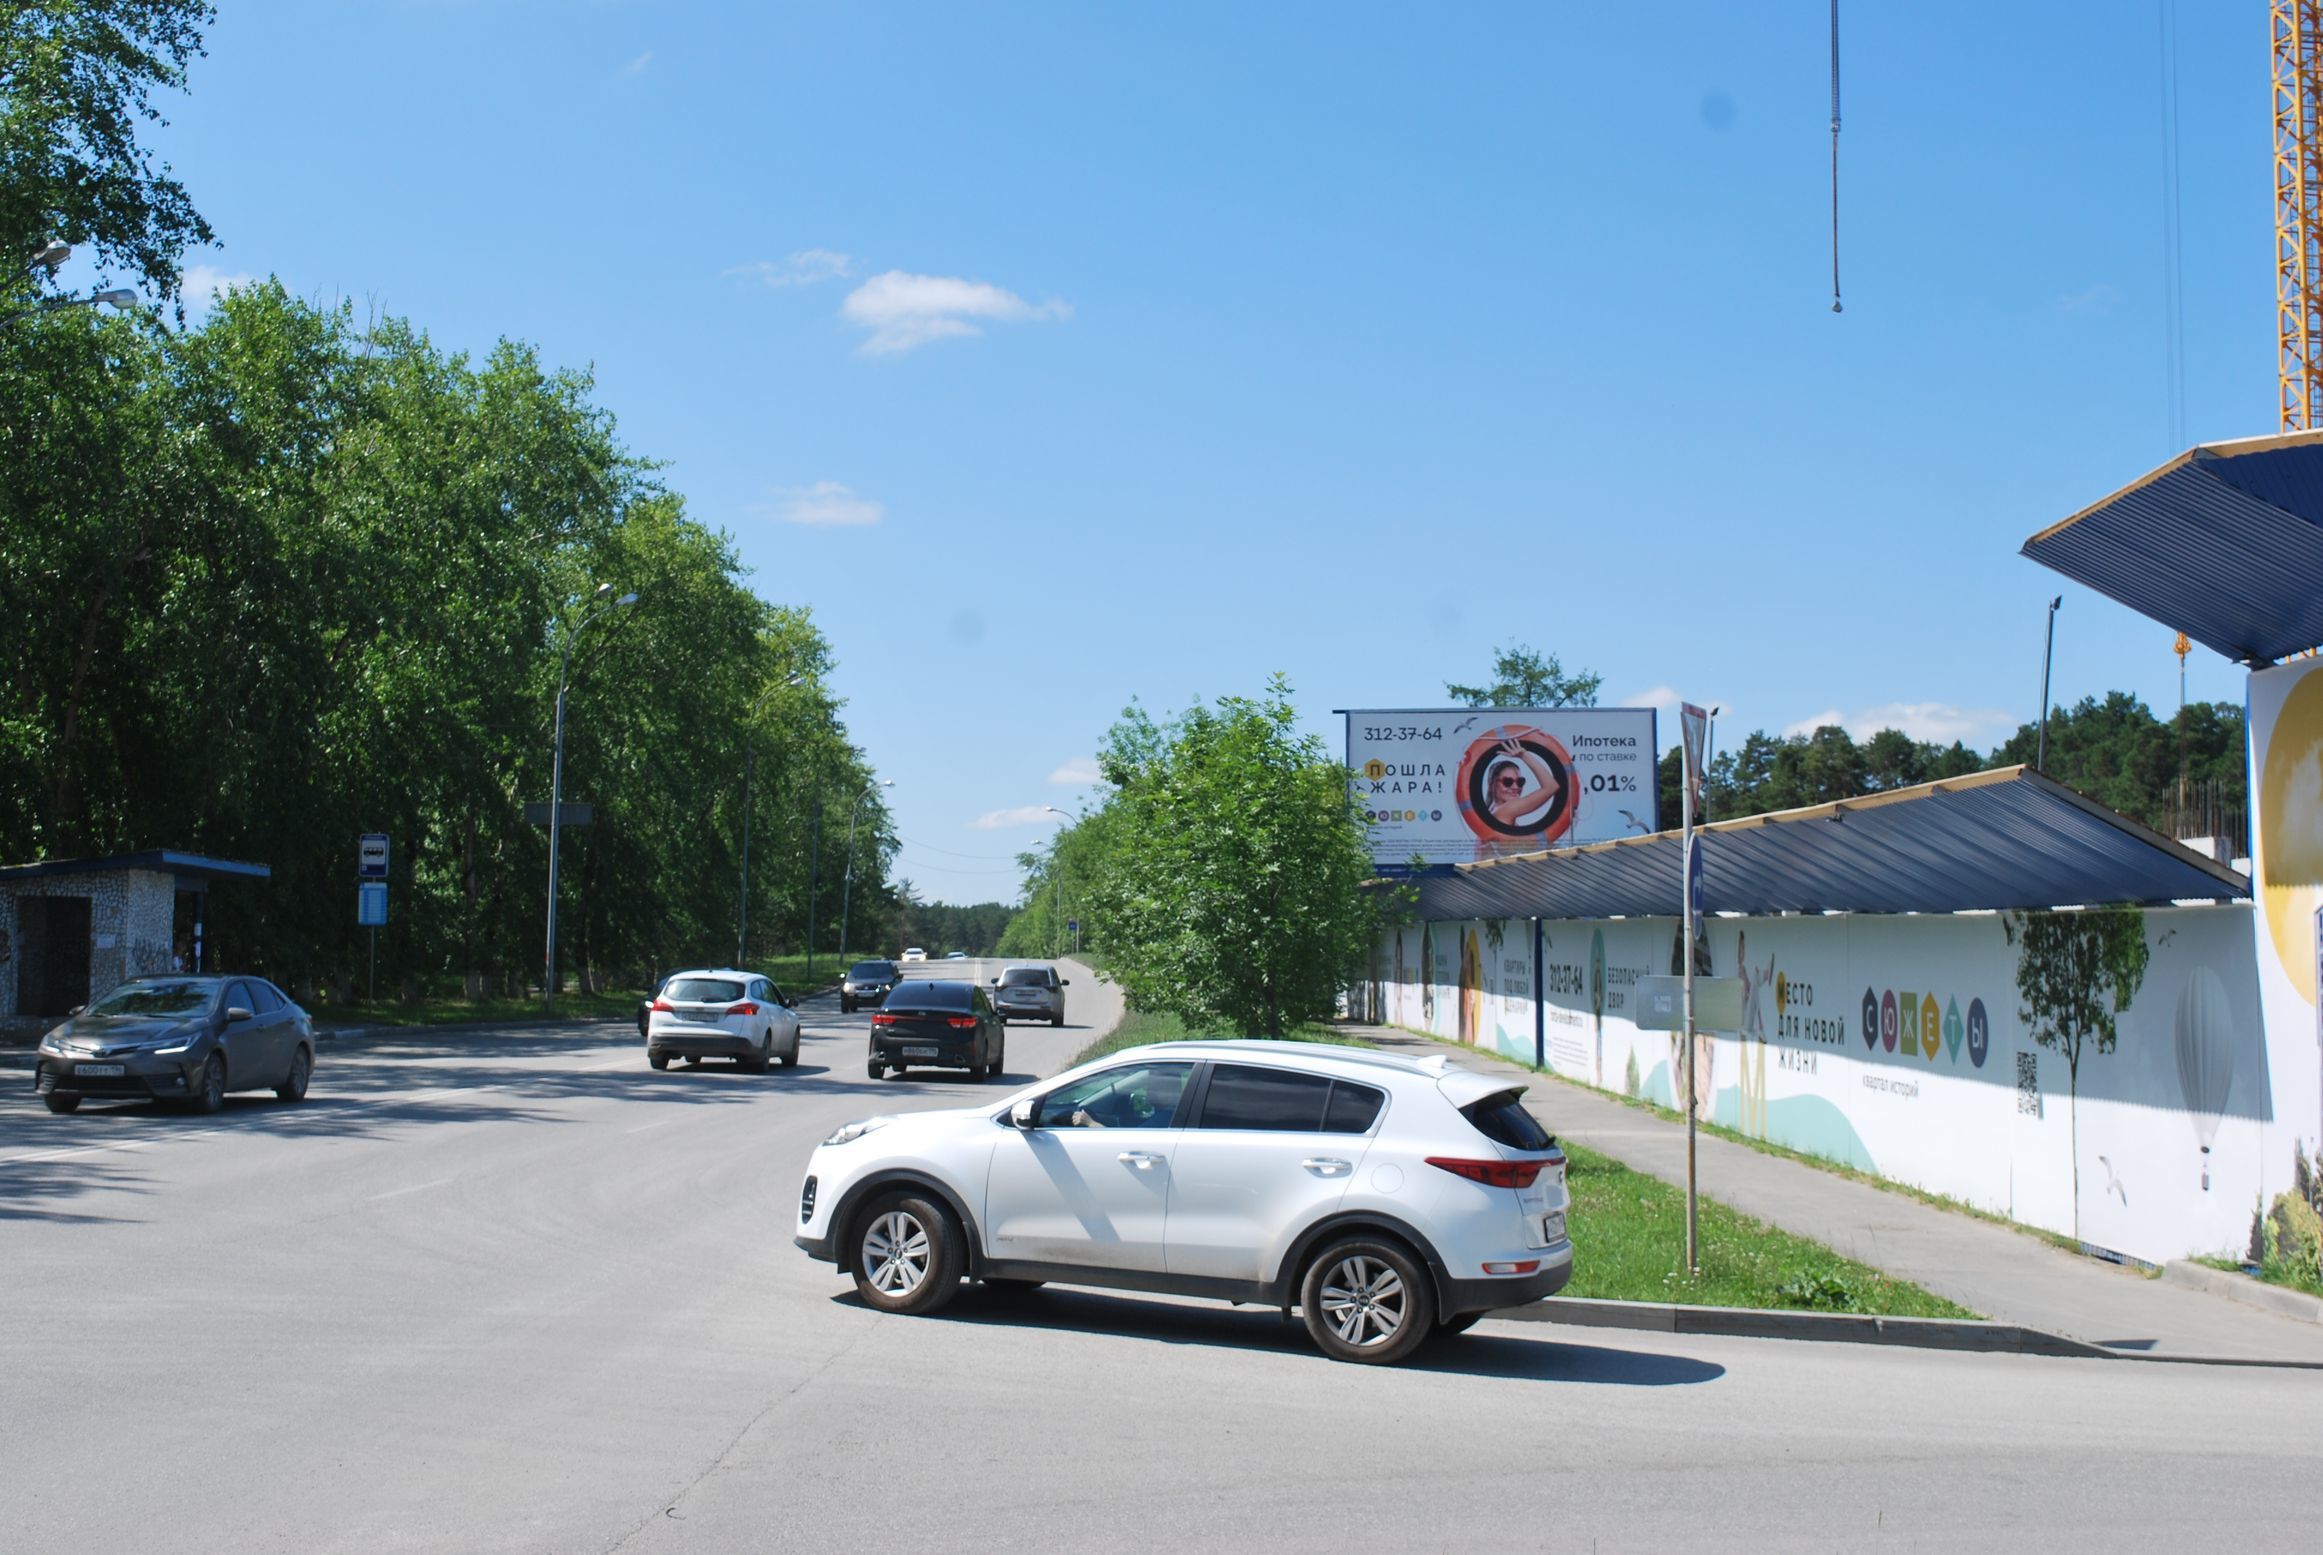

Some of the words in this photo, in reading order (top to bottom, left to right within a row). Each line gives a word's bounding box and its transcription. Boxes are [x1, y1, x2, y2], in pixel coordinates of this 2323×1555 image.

[1364, 727, 1442, 741] 312-37-64
[1572, 735, 1637, 747] Ипотека
[1580, 753, 1594, 762] по
[1597, 753, 1637, 762] ставке
[1370, 764, 1446, 776] ПОШЛА
[1370, 781, 1442, 794] ЖАРА!
[1549, 964, 1583, 996] 312-37-64
[1778, 1014, 1799, 1041] ДЛЯ
[1805, 1016, 1845, 1046] НОВОЙ
[1779, 1046, 1817, 1075] ЖИЗНИ
[1863, 1074, 1889, 1093] квартал
[1890, 1079, 1919, 1098] историй
